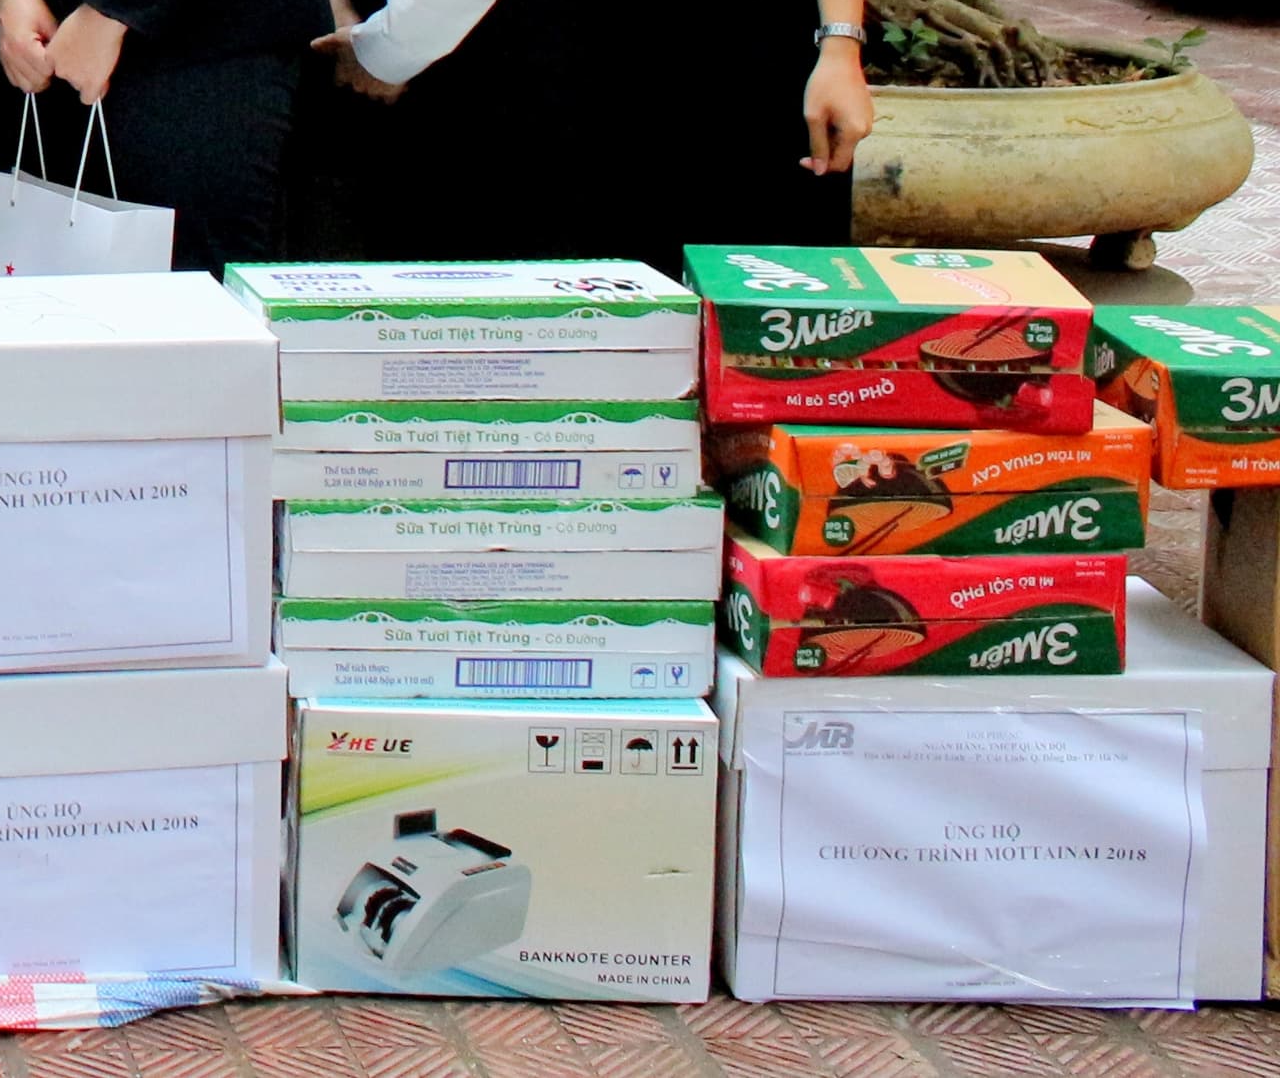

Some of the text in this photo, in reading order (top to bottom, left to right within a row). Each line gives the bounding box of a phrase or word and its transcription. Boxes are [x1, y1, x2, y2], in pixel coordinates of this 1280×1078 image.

[447, 327, 475, 342] Tiệt
[479, 327, 523, 344] Trùng
[445, 430, 471, 443] Tiệt
[475, 431, 519, 445] Trùng
[1003, 454, 1044, 472] CHUA
[40, 469, 68, 488] HỘ
[971, 465, 1001, 487] CAY
[32, 487, 145, 507] MOTTAINAI
[151, 483, 188, 499] 2018
[456, 631, 481, 643] Tiệt
[485, 631, 530, 645] Trùng
[54, 802, 82, 819] HỘ
[46, 820, 156, 840] MOTTAINAI
[163, 816, 199, 831] 2018
[992, 823, 1021, 842] HỘ
[819, 844, 1146, 862] CHƯƠNG TRÌNH MOTTAINAI 2018
[519, 950, 691, 967] BANKNOTE COUNTER
[597, 973, 691, 985] MADE IN CHINA
